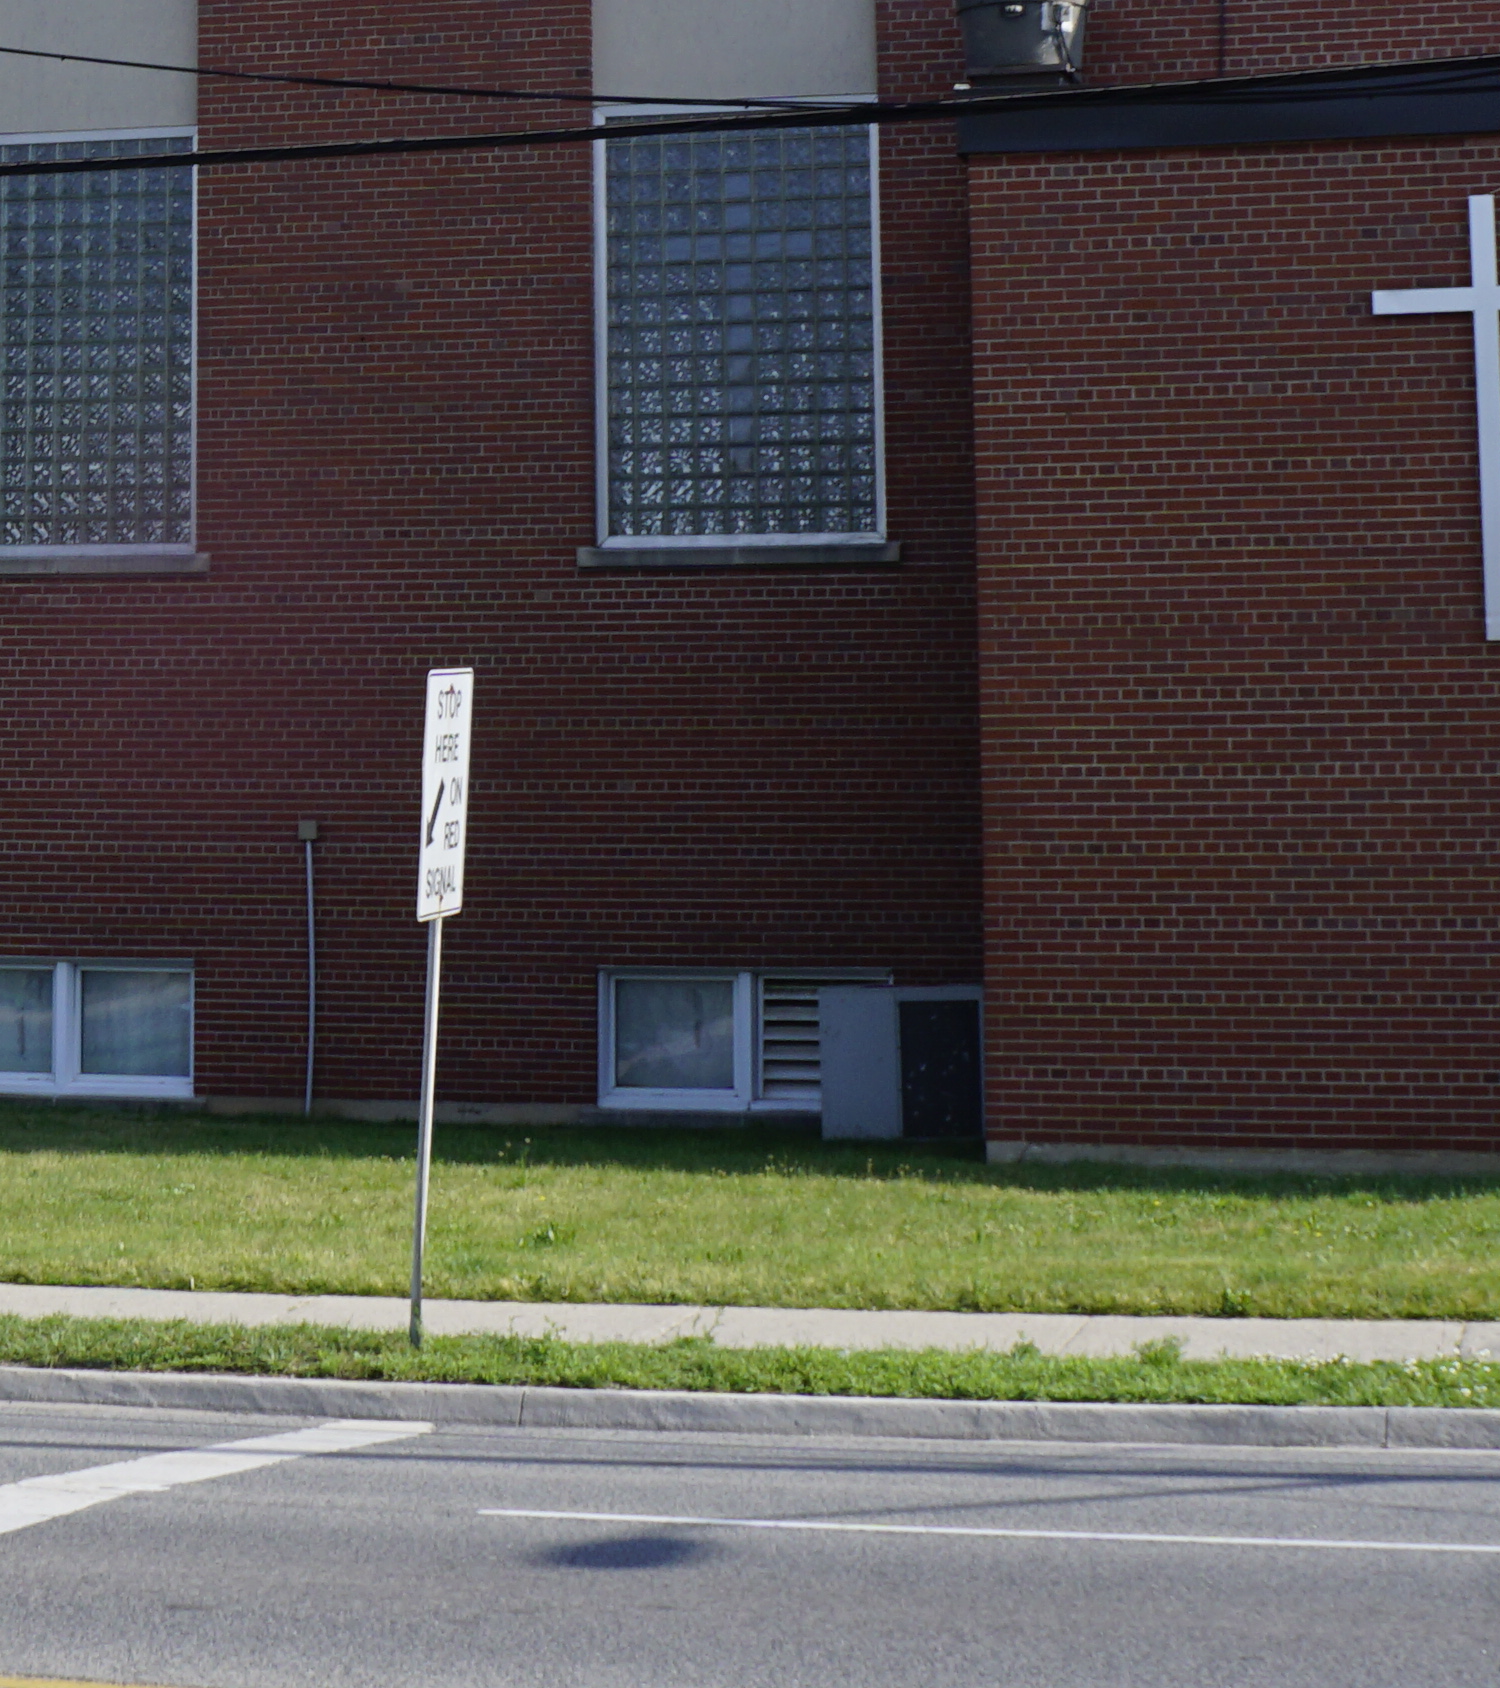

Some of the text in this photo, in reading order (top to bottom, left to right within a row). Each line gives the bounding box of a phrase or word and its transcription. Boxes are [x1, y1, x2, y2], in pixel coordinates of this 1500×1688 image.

[437, 689, 463, 720] STOP
[434, 733, 459, 764] HERE
[449, 776, 463, 806] ON
[443, 820, 460, 850] RED
[425, 865, 457, 900] SIGNAL
